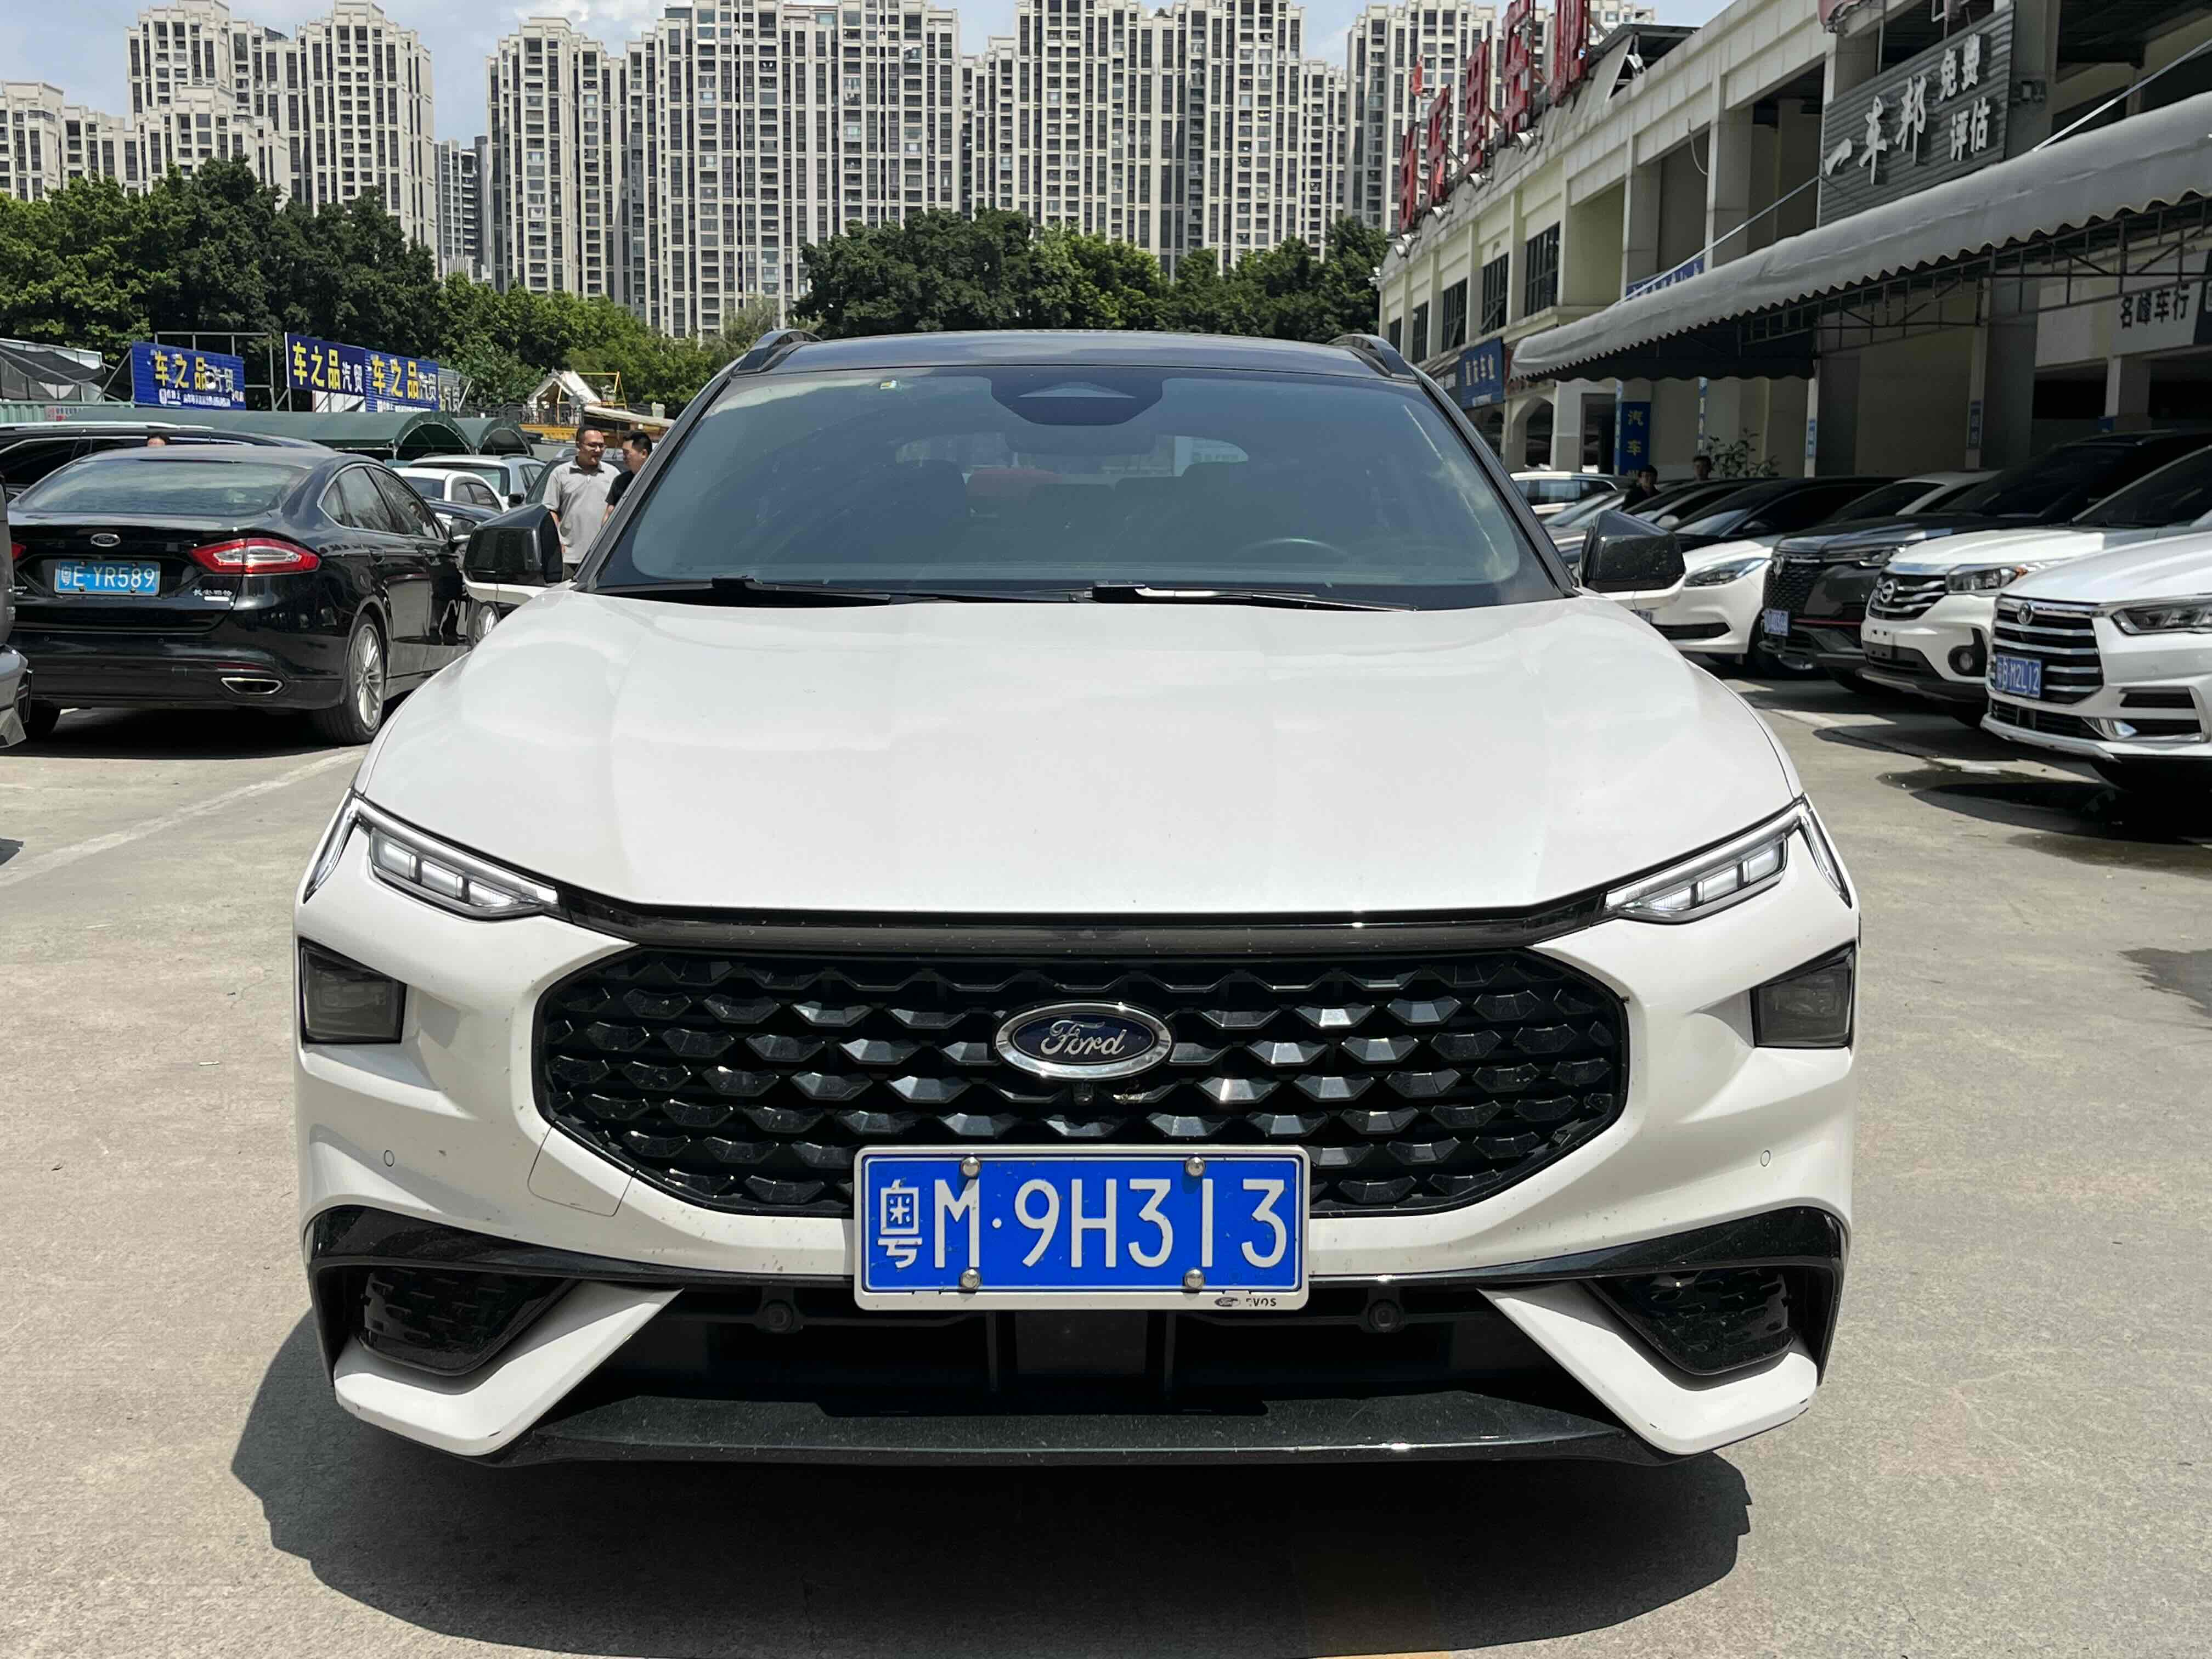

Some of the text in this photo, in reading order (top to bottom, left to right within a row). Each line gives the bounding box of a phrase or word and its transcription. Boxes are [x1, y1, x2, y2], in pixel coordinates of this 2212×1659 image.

[1950, 97, 1991, 161] 评估
[292, 341, 363, 393] 车之品汽贸
[1041, 1019, 1127, 1055] Ford
[877, 1177, 1288, 1268] 粤M·9H313
